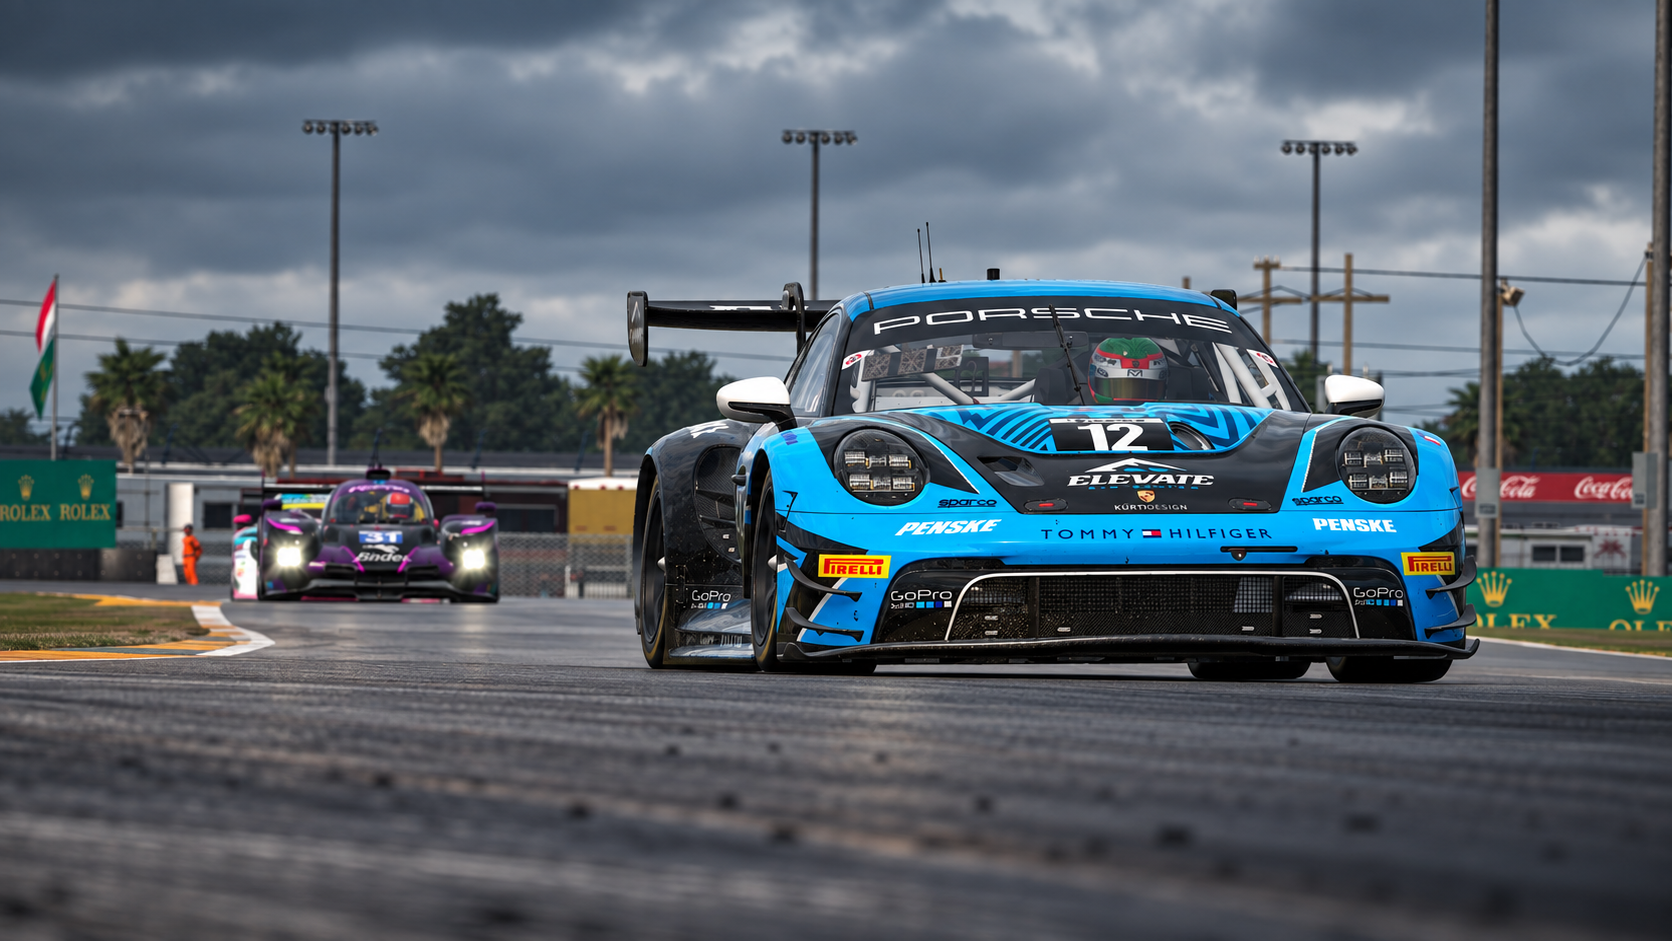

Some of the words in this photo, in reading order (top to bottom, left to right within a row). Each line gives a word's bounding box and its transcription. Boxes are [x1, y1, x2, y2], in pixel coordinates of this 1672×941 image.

[874, 307, 1232, 335] PORSCHE
[1077, 423, 1149, 451] 12
[1067, 474, 1215, 487] ELEVATE
[937, 498, 998, 509] sparco
[0, 503, 51, 521] ROLEX
[59, 503, 111, 521] ROLEX
[894, 518, 1002, 536] PENSKE
[1312, 518, 1397, 533] PENSKE
[1041, 528, 1134, 540] TOMMY
[1170, 528, 1272, 540] HILFIGER
[823, 558, 884, 575] PIRELLI
[1407, 556, 1452, 572] PIRELLI
[691, 589, 731, 602] GoPro
[890, 589, 952, 601] GoPro
[1353, 587, 1404, 599] GoPro
